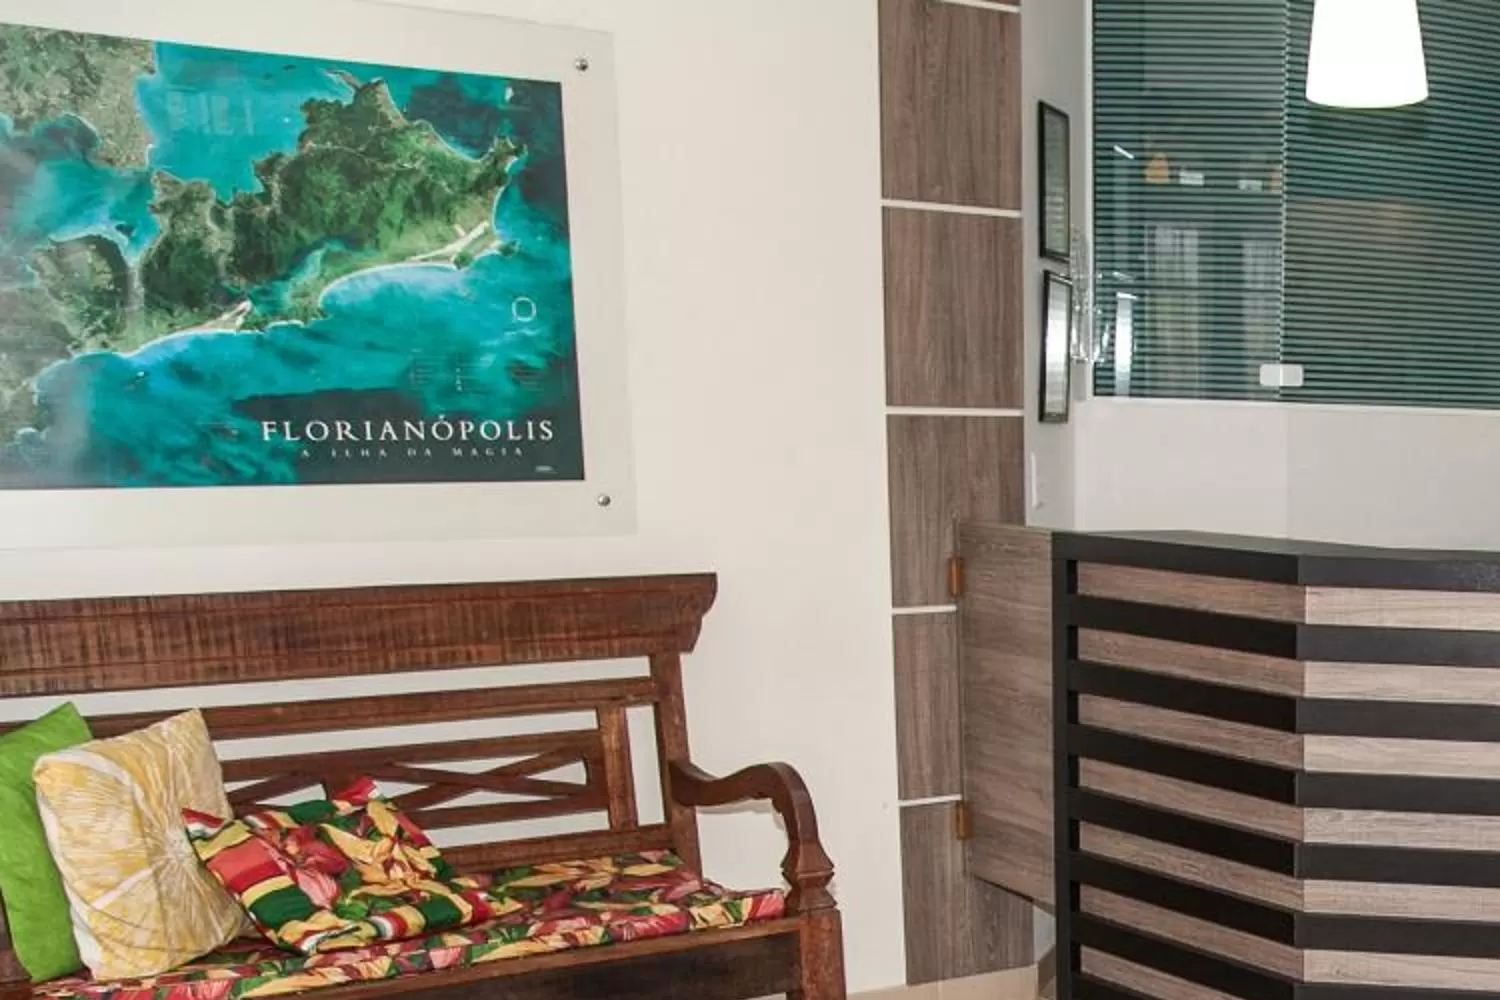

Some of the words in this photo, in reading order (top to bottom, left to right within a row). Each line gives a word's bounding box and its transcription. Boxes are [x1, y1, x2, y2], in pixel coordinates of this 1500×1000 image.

[262, 414, 554, 441] FLORIANÓPOLIS
[302, 449, 310, 457] A
[407, 447, 431, 457] DA
